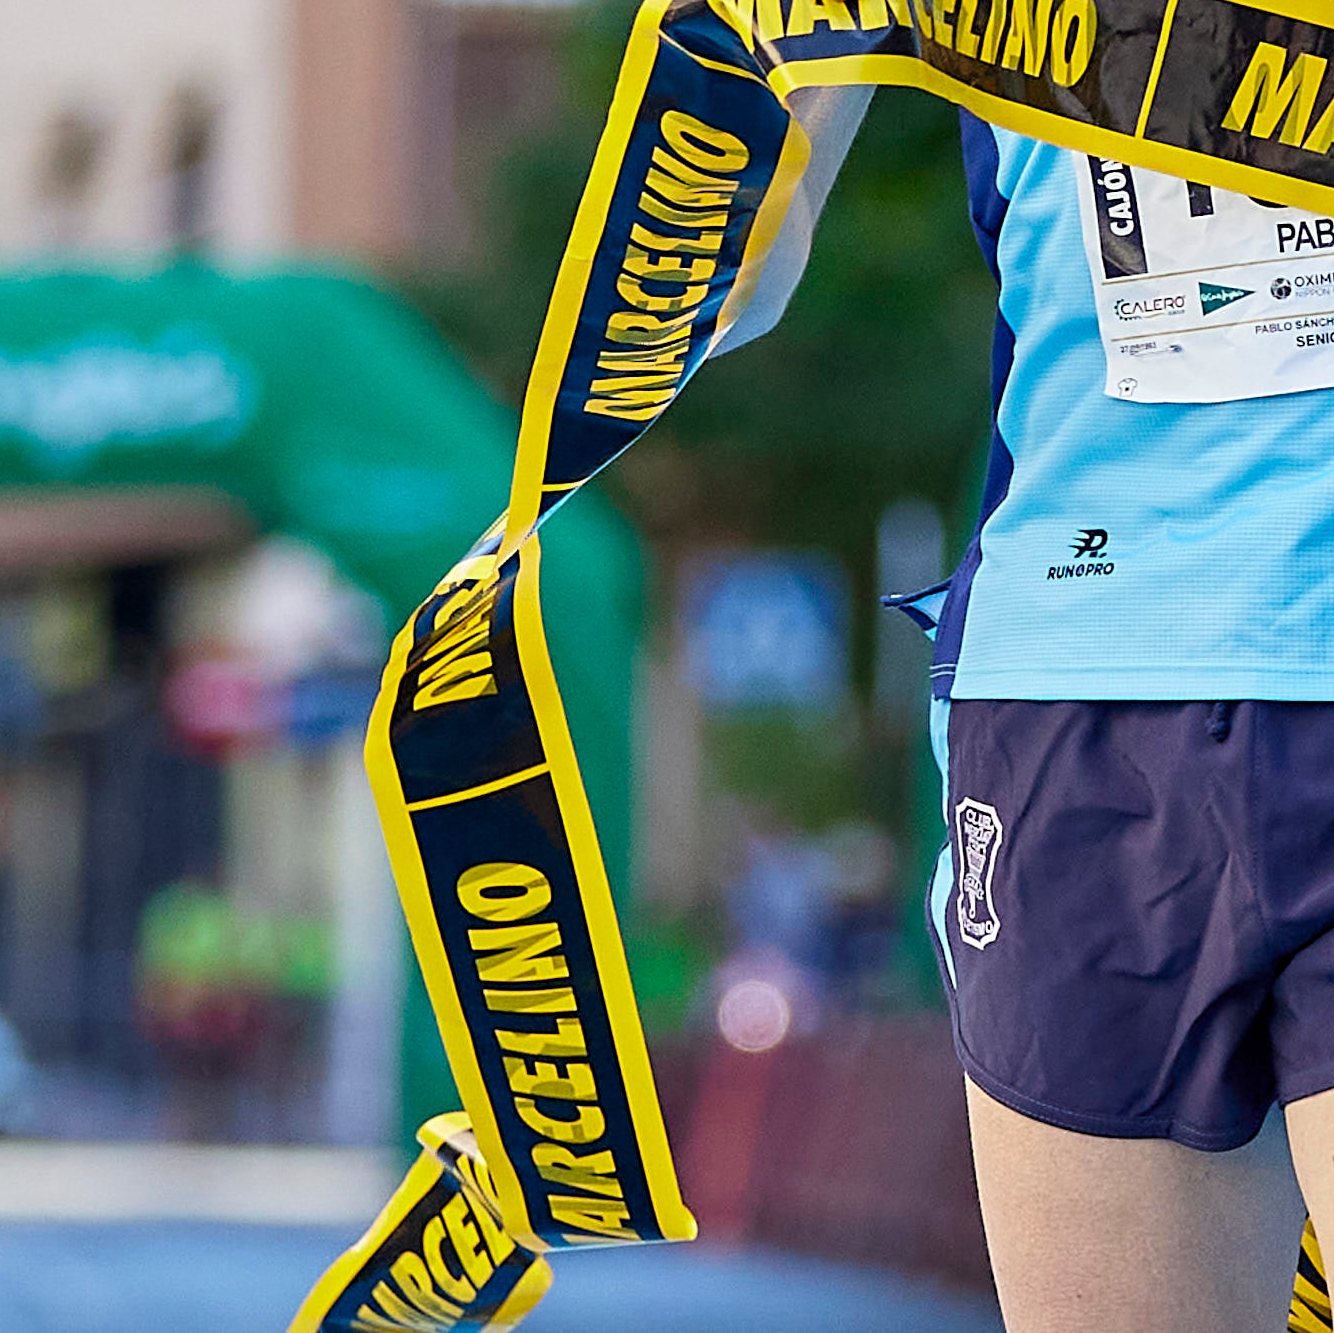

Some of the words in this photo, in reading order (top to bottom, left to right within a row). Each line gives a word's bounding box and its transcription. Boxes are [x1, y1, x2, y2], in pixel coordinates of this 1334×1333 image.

[583, 109, 752, 422] MARCELINO
[1295, 286, 1330, 299] NIPPON
[1120, 295, 1185, 315] CALERO
[1255, 322, 1292, 334] PABLO
[455, 862, 643, 1243] ARCELINO
